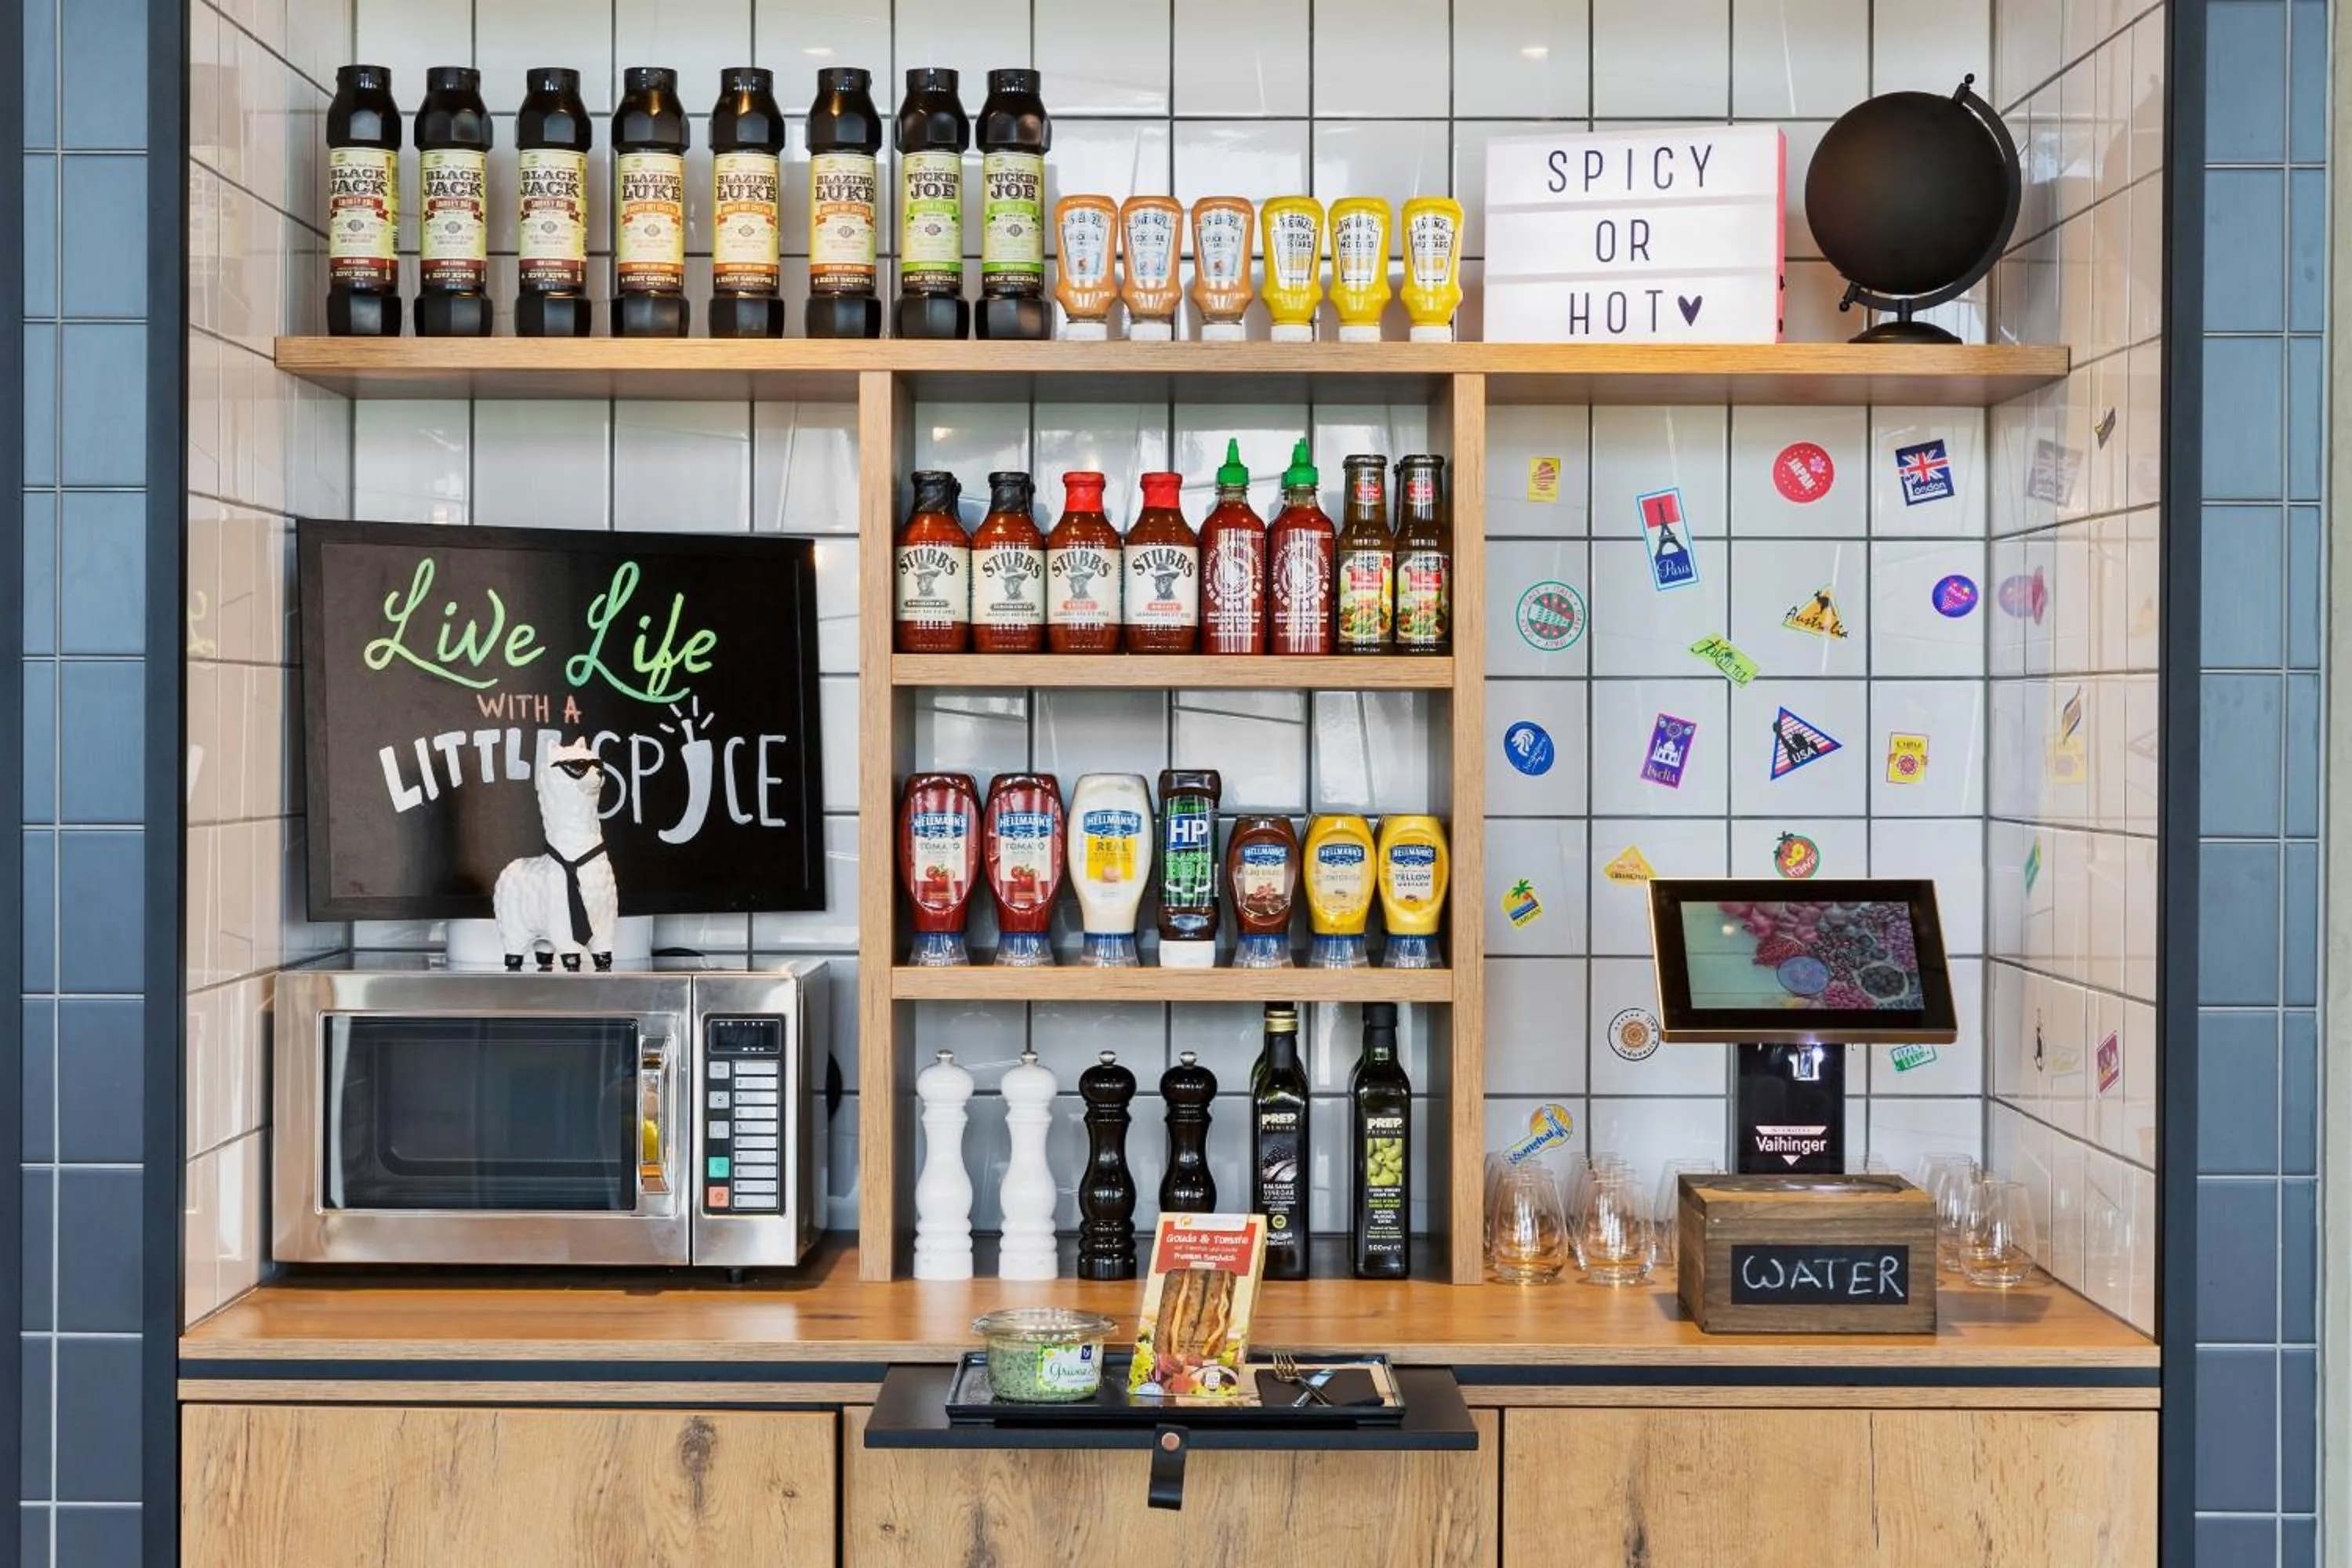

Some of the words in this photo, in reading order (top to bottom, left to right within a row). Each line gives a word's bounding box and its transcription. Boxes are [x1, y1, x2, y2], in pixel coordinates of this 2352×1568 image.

[330, 169, 386, 181] BLACK
[426, 170, 482, 181] BLACK
[522, 170, 578, 182] BLACK
[1548, 143, 1713, 193] SPICY
[623, 175, 681, 186] BLAZING
[717, 175, 776, 186] BLAZING
[816, 175, 873, 186] BLAZING
[907, 172, 959, 184] TUCKER
[985, 172, 1039, 185] TUCKER
[330, 180, 387, 196] JACK
[424, 181, 483, 198] JACK
[521, 181, 579, 198] JACK
[622, 185, 681, 202] LUKE
[717, 184, 777, 202] LUKE
[815, 185, 874, 202] LUKE
[910, 183, 956, 200] JOE
[990, 183, 1036, 201] JOE
[1595, 219, 1650, 263] OR
[1570, 289, 1664, 336] HOT
[1786, 457, 1817, 491] JAPAN
[1905, 476, 1948, 500] London
[899, 548, 959, 575] STUBB'S
[982, 551, 1042, 579] STUBB'S
[1051, 550, 1112, 578] STUBB'S
[1131, 548, 1196, 578] STUBB'S
[1657, 559, 1690, 578] Paris
[363, 557, 546, 689] Live
[565, 561, 717, 704] Life
[477, 692, 549, 724] WITH
[563, 695, 583, 724] A
[1792, 748, 1817, 763] USA
[1170, 819, 1209, 843] HP
[920, 842, 960, 851] TOMAO
[1005, 842, 1045, 851] TOMAO
[1097, 841, 1128, 851] REAL
[1261, 1113, 1297, 1125] PREP
[1367, 1117, 1403, 1129] PREP
[1756, 1136, 1827, 1154] Vaihinger
[1167, 1233, 1197, 1243] Gouda
[1200, 1234, 1210, 1243] &
[1214, 1235, 1249, 1245] Tomate
[1743, 1255, 1904, 1298] WATER
